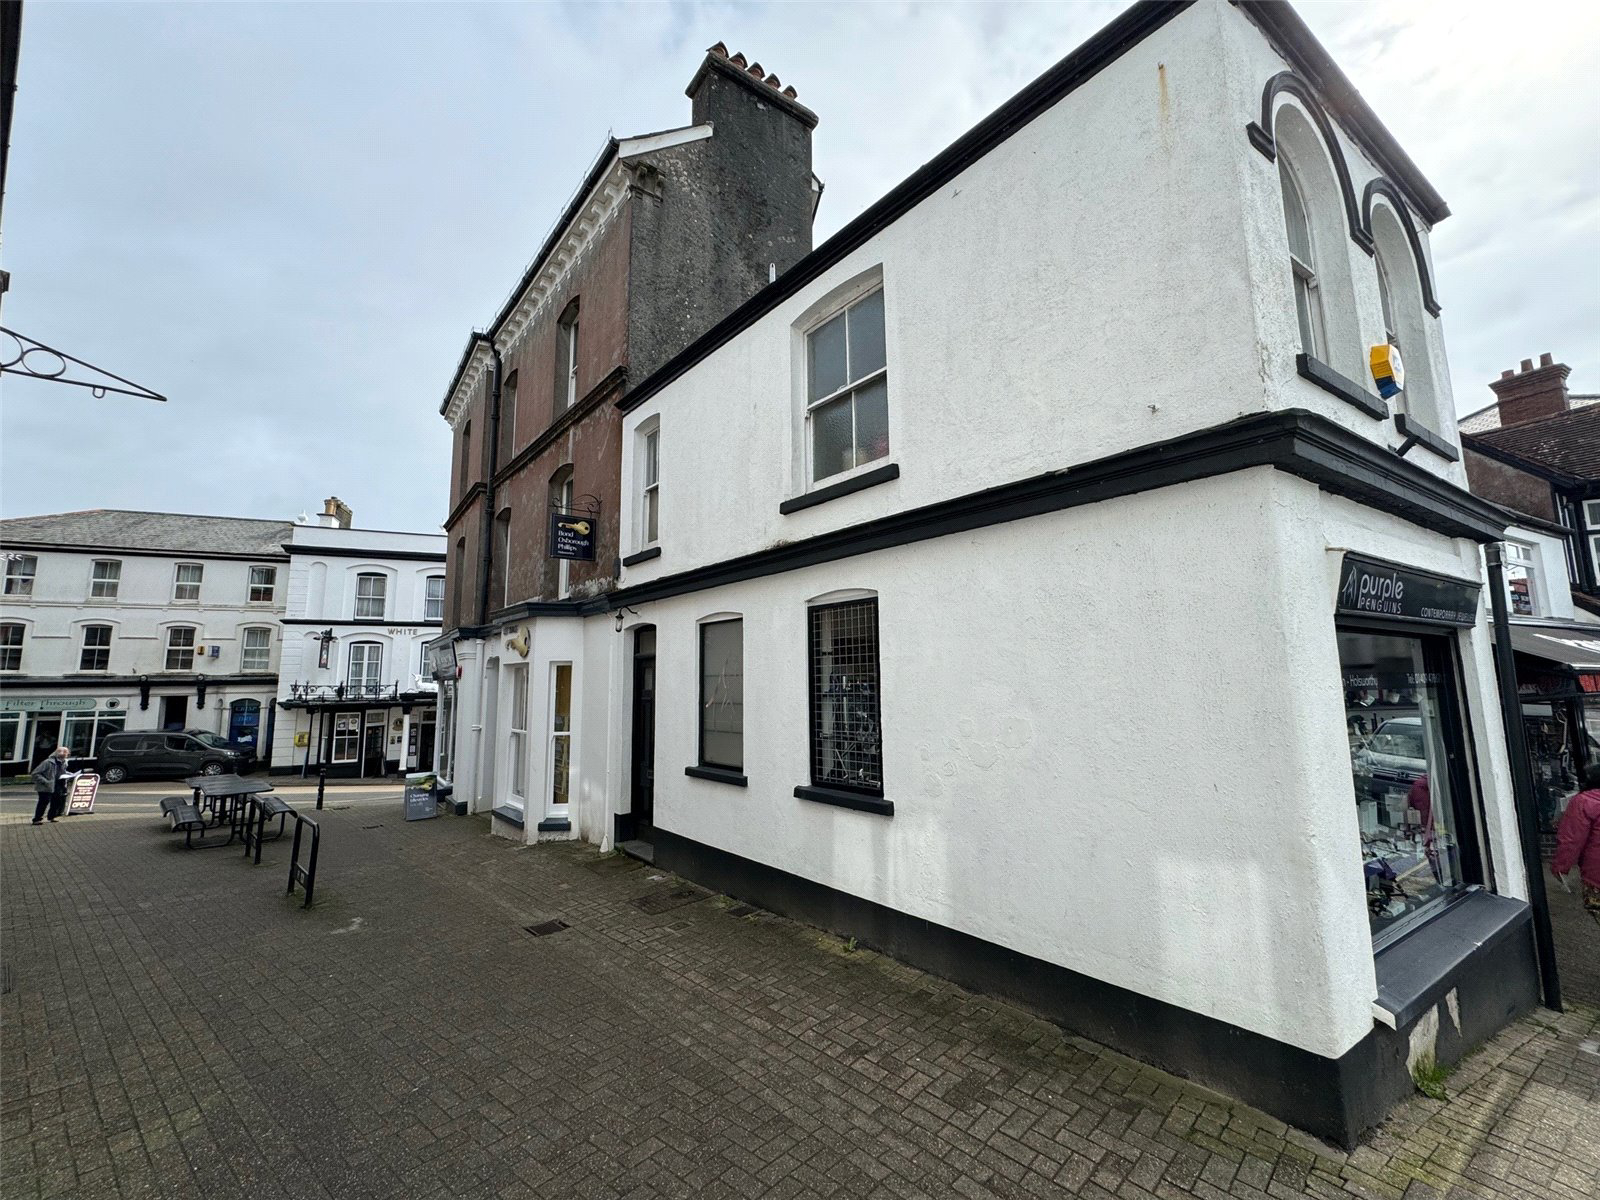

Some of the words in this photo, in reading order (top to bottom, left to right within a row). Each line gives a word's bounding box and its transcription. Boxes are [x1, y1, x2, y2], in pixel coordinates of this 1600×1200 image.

[558, 530, 574, 538] Bond
[1357, 572, 1404, 608] purple
[1360, 598, 1402, 614] PENGUINS
[1420, 607, 1456, 620] CONTEMPORARY
